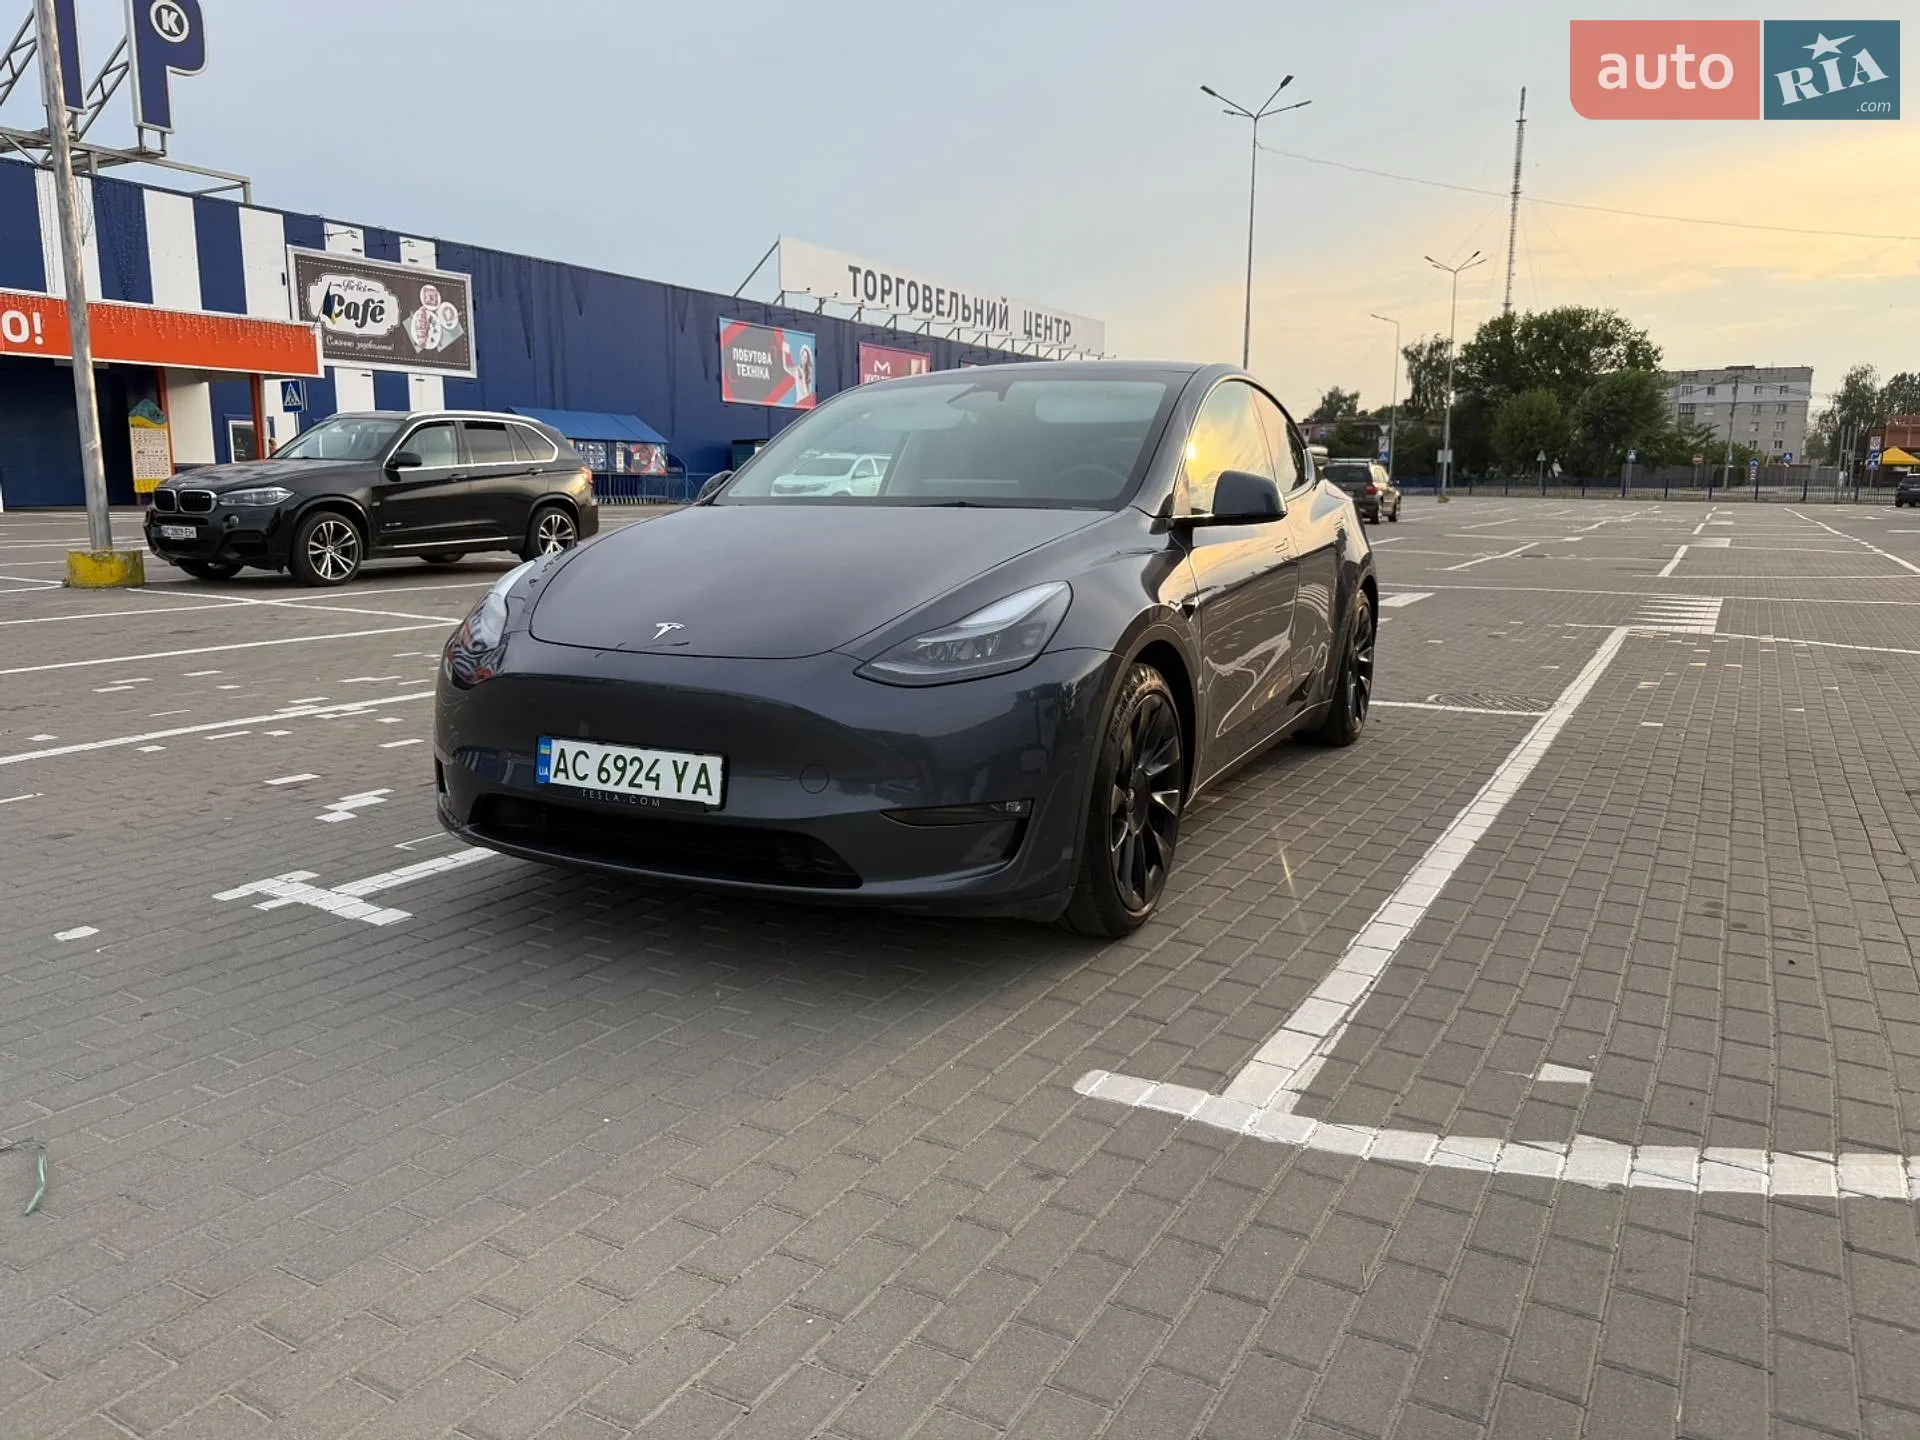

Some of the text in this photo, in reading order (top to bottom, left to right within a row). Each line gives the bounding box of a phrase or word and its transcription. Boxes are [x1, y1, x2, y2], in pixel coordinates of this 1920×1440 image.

[326, 293, 386, 329] Café
[848, 264, 1072, 344] ТОРГОВЕЛЬНИЙ ЦЕНТР
[732, 347, 773, 365] ПОБУТОВА
[736, 363, 770, 380] ТЕХНІКА
[538, 766, 549, 776] UA
[553, 748, 713, 796] AC 6924 YA
